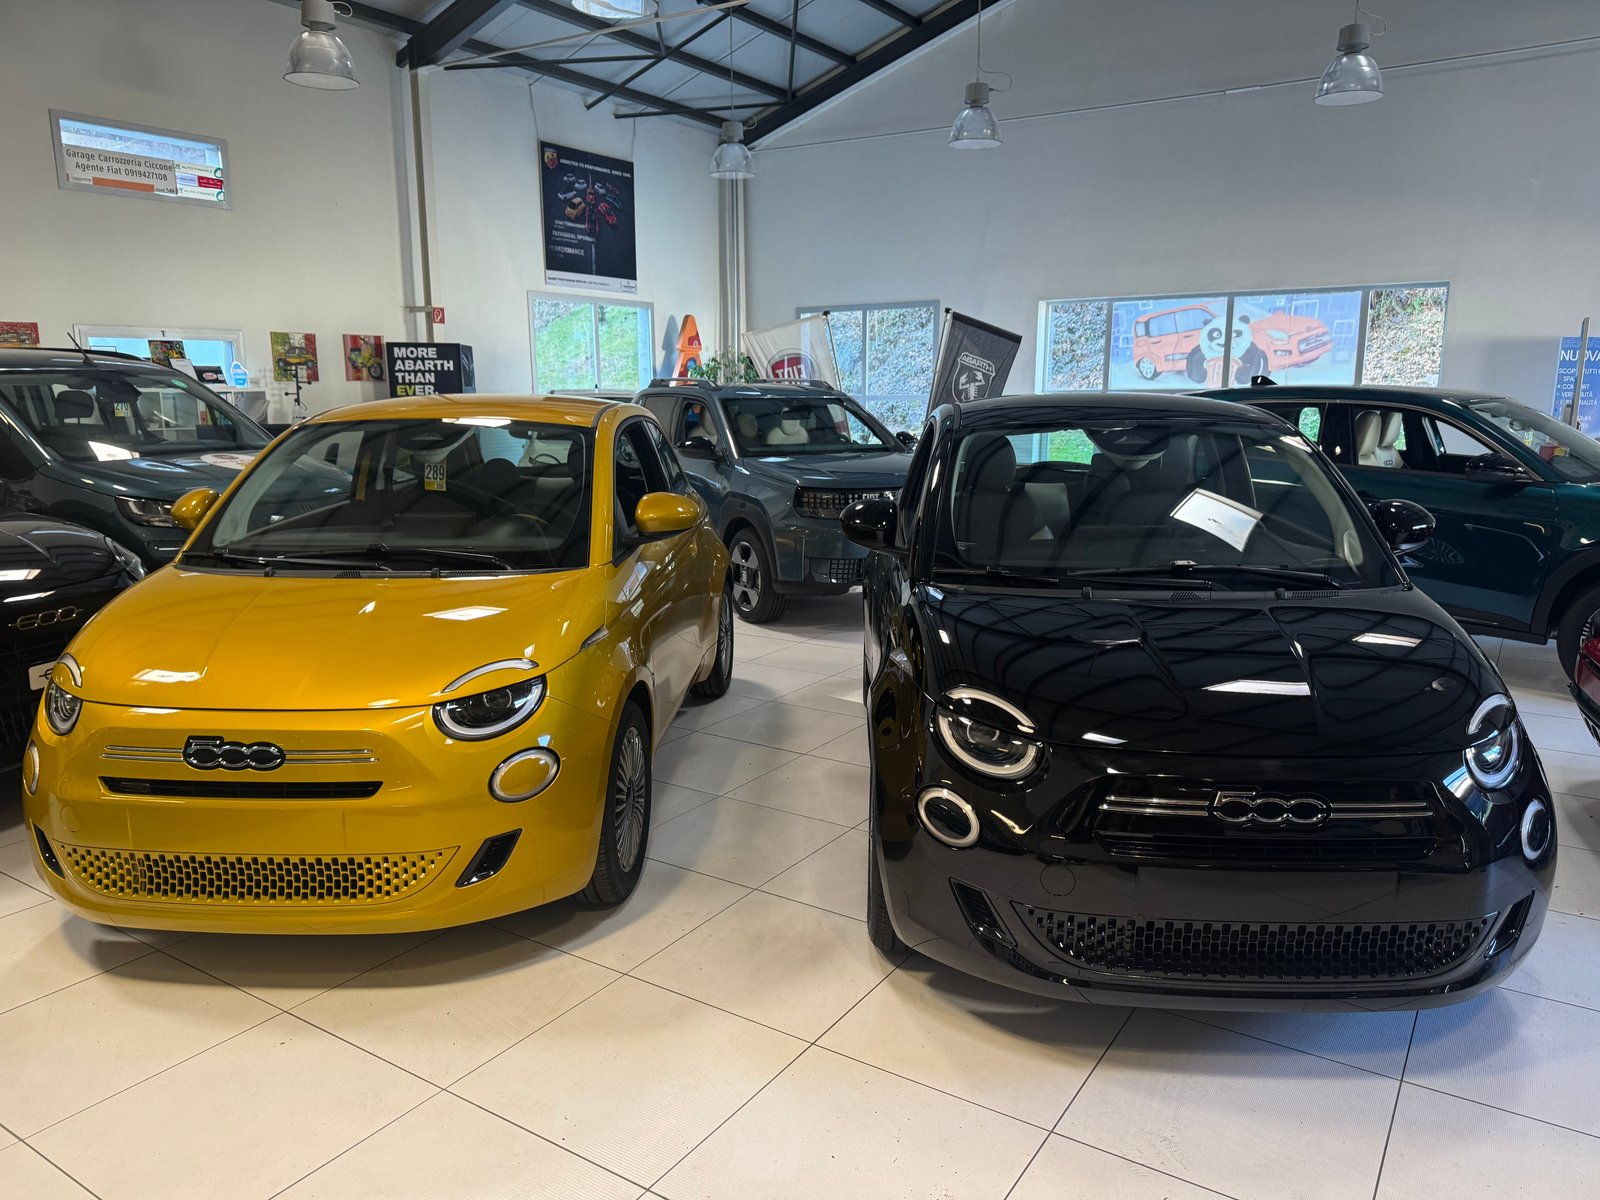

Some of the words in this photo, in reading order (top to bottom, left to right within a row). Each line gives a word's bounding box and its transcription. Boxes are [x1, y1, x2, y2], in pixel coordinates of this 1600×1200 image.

[65, 149, 95, 161] Garage
[98, 154, 141, 167] Carrozzeria
[144, 161, 173, 172] Ciccone
[75, 161, 104, 172] Agente
[107, 166, 121, 175] Fiat
[124, 169, 168, 181] 0919427108
[394, 347, 437, 358] MORE
[394, 360, 454, 371] ABARTH
[962, 355, 993, 372] ABARTH
[395, 372, 435, 383] THAN
[396, 385, 439, 396] EVER.
[426, 464, 445, 480] 289
[186, 738, 282, 769] 500
[1213, 790, 1327, 824] 500
